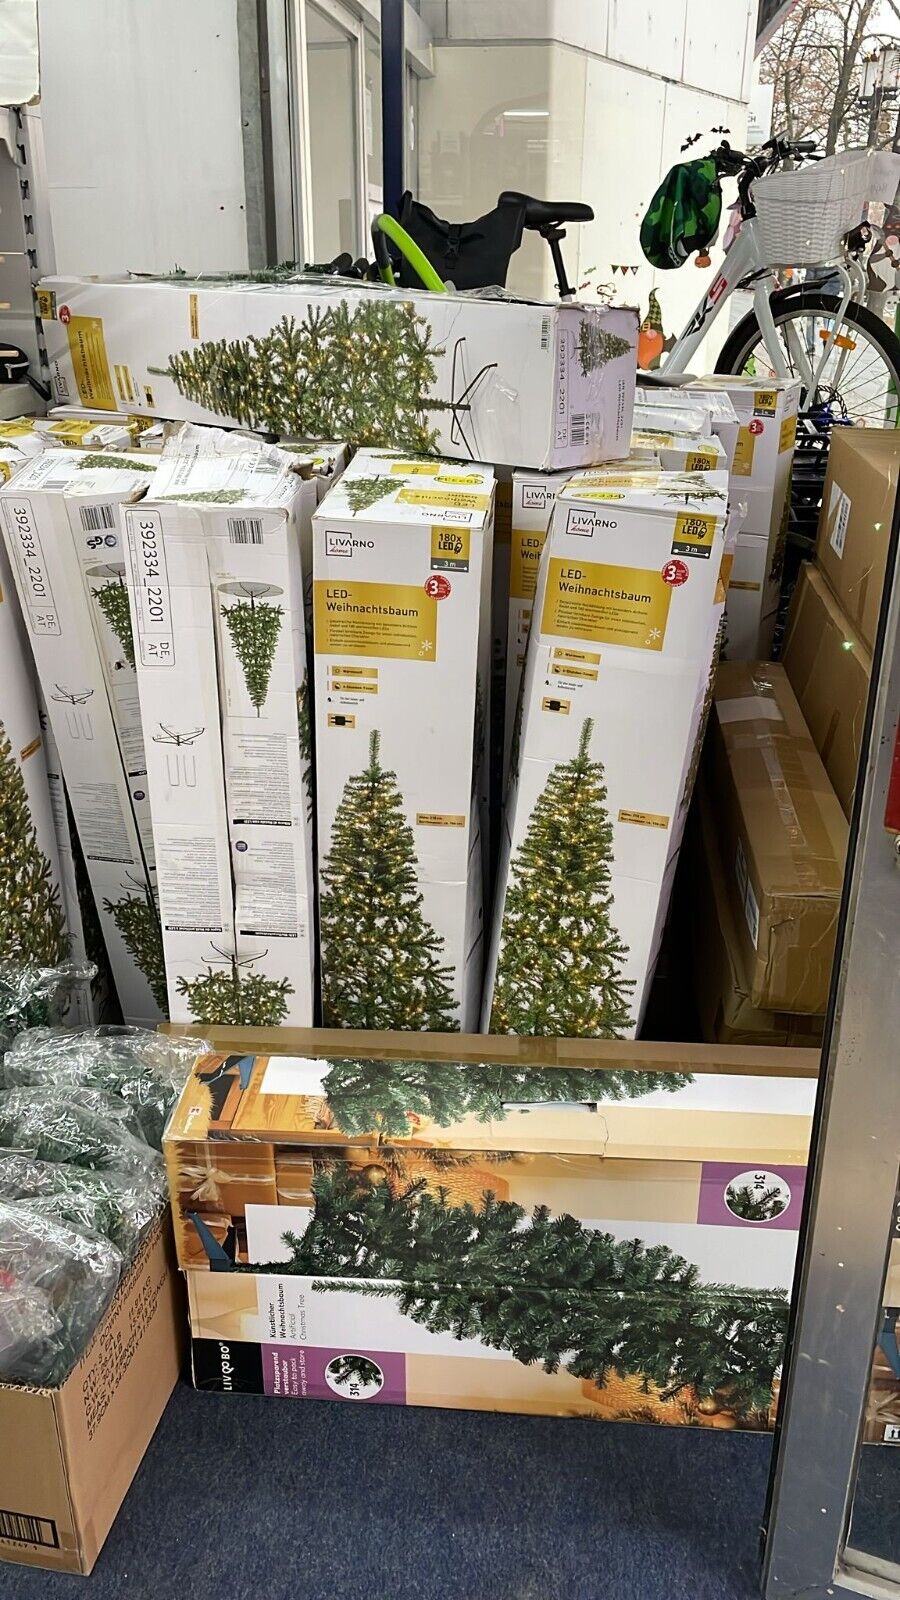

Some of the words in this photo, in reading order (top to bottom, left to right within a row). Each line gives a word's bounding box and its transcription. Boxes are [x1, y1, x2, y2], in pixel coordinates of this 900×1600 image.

[572, 516, 618, 529] LIVARNO
[684, 518, 708, 528] 180x
[438, 533, 462, 542] 180x
[682, 526, 698, 535] LED
[329, 538, 375, 548] LIVARNO
[438, 542, 453, 550] LED
[14, 508, 46, 598] 392334_2201
[140, 521, 164, 623] 392334_2201
[560, 568, 587, 580] LED-
[666, 564, 676, 580] 3
[326, 588, 353, 598] LED-
[430, 580, 438, 594] 3
[558, 582, 652, 604] Weihnachtsbaum
[326, 602, 418, 617] Weihnachtsbaum
[36, 615, 46, 628] AT
[148, 644, 158, 656] AT
[160, 642, 170, 659] DE,
[754, 1174, 766, 1190] 314
[278, 1283, 287, 1338] Weihnachtsbaum
[268, 1302, 276, 1338] Künstlicher
[290, 1358, 298, 1372] pack
[272, 1352, 280, 1394] Platzsparend
[282, 1360, 290, 1394] verstaubar
[292, 1372, 298, 1380] to
[350, 1383, 360, 1396] 314
